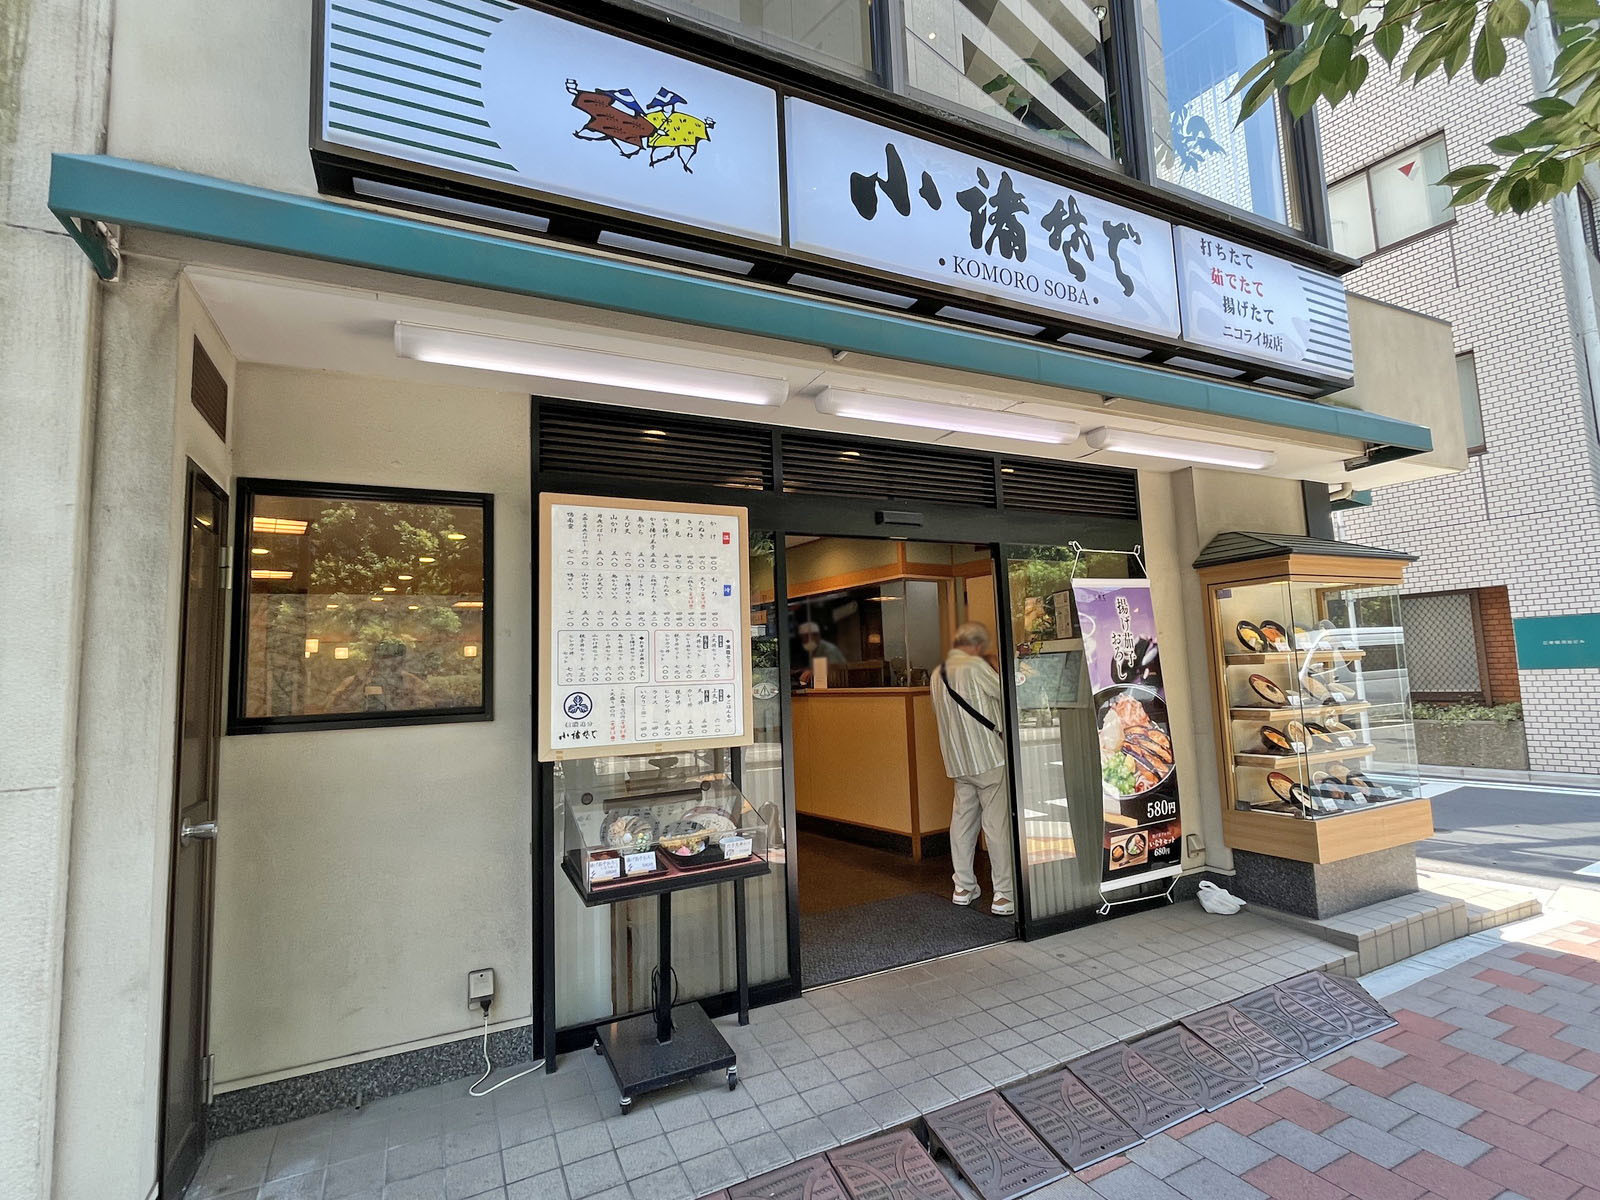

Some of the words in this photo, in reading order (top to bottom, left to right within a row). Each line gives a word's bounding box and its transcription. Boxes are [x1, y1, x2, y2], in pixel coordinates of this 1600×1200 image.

[1199, 237, 1255, 270] 打ちたて
[953, 256, 1041, 293] KOMORO
[1044, 278, 1091, 307] SOBA
[1210, 268, 1265, 298] 茹でたて
[1221, 296, 1275, 326] 揚げたて
[1221, 326, 1285, 354] ニコライ坂店
[610, 514, 618, 534] 山かけ
[624, 516, 632, 535] えび天
[675, 518, 682, 538] 月見
[686, 520, 694, 538] きつね
[710, 521, 716, 540] かけ
[566, 548, 574, 566] 七一〇
[596, 550, 604, 566] 五八〇
[610, 550, 618, 567] 五八〇
[624, 552, 632, 568] 六一〇
[712, 576, 718, 597] もり
[566, 610, 574, 626] 七一〇
[582, 610, 590, 626] 五八〇
[596, 610, 604, 626] 六一〇
[1116, 597, 1136, 667] 揚げ茄子
[1112, 632, 1128, 680] おろし
[1146, 800, 1176, 819] 580円
